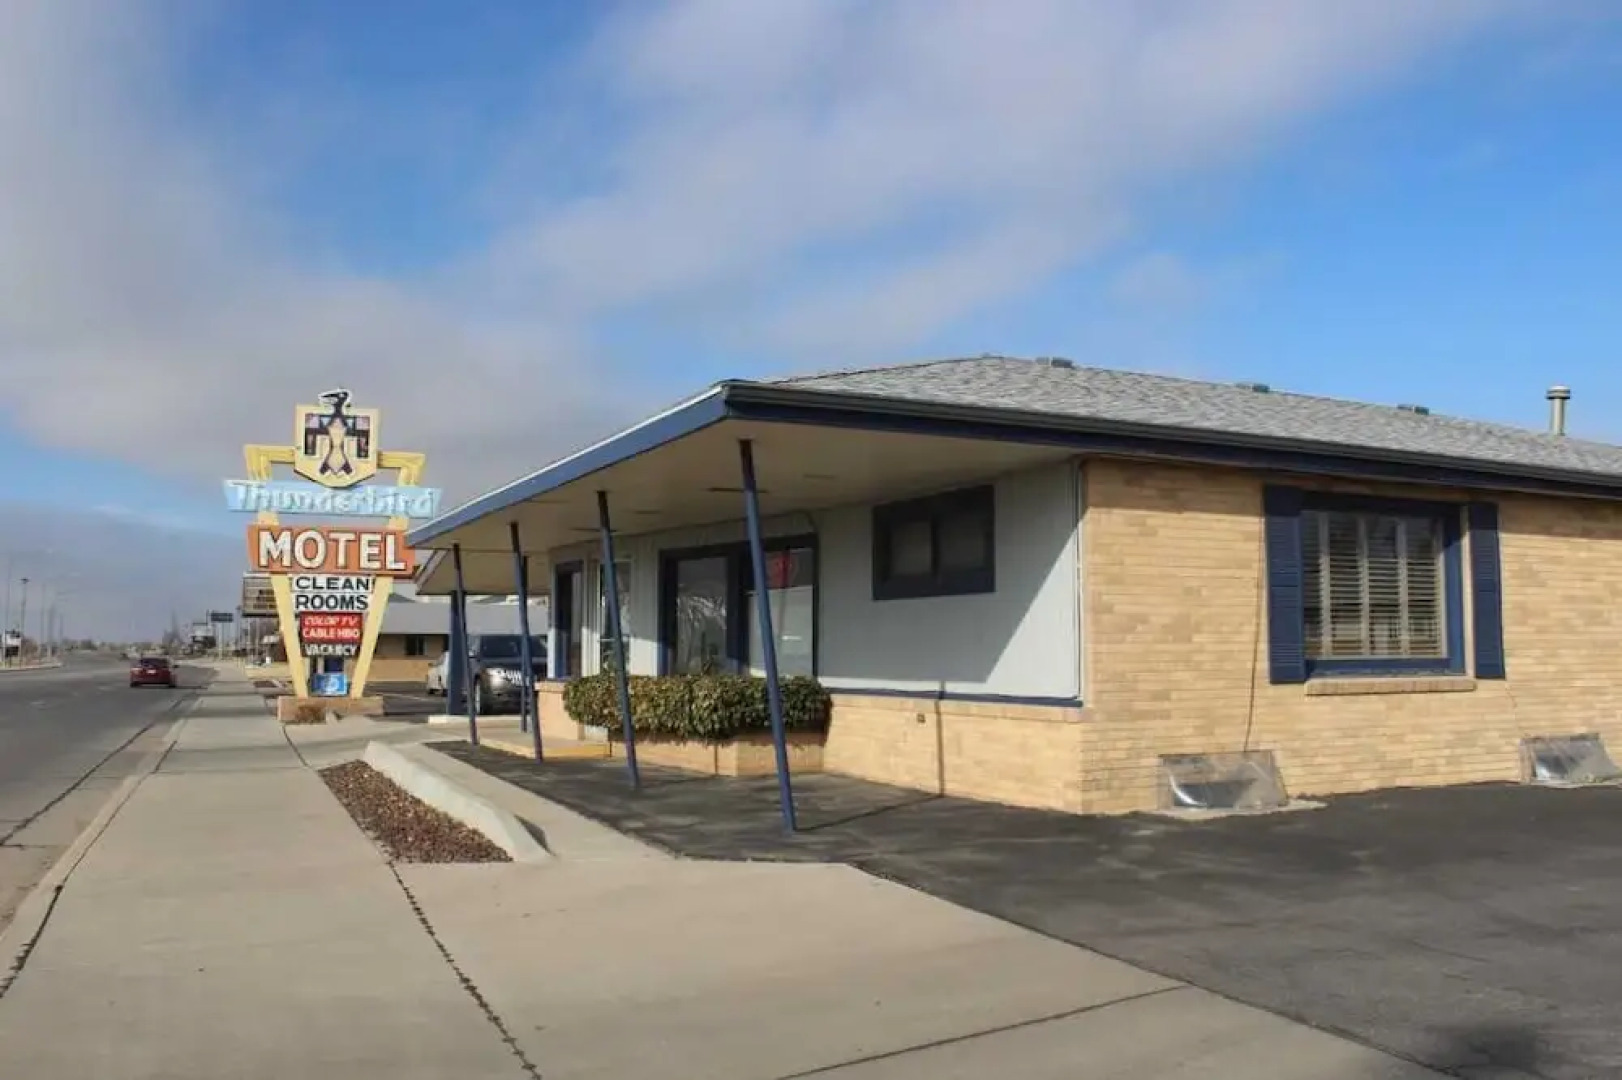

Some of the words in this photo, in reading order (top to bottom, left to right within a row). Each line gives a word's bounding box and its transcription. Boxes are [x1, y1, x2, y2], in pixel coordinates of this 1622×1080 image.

[230, 482, 433, 515] Thunderbird
[258, 530, 406, 570] MOTEL
[296, 577, 369, 590] CLEAN
[295, 594, 369, 610] ROOMS
[303, 628, 335, 639] CABLE
[338, 628, 360, 638] HBO
